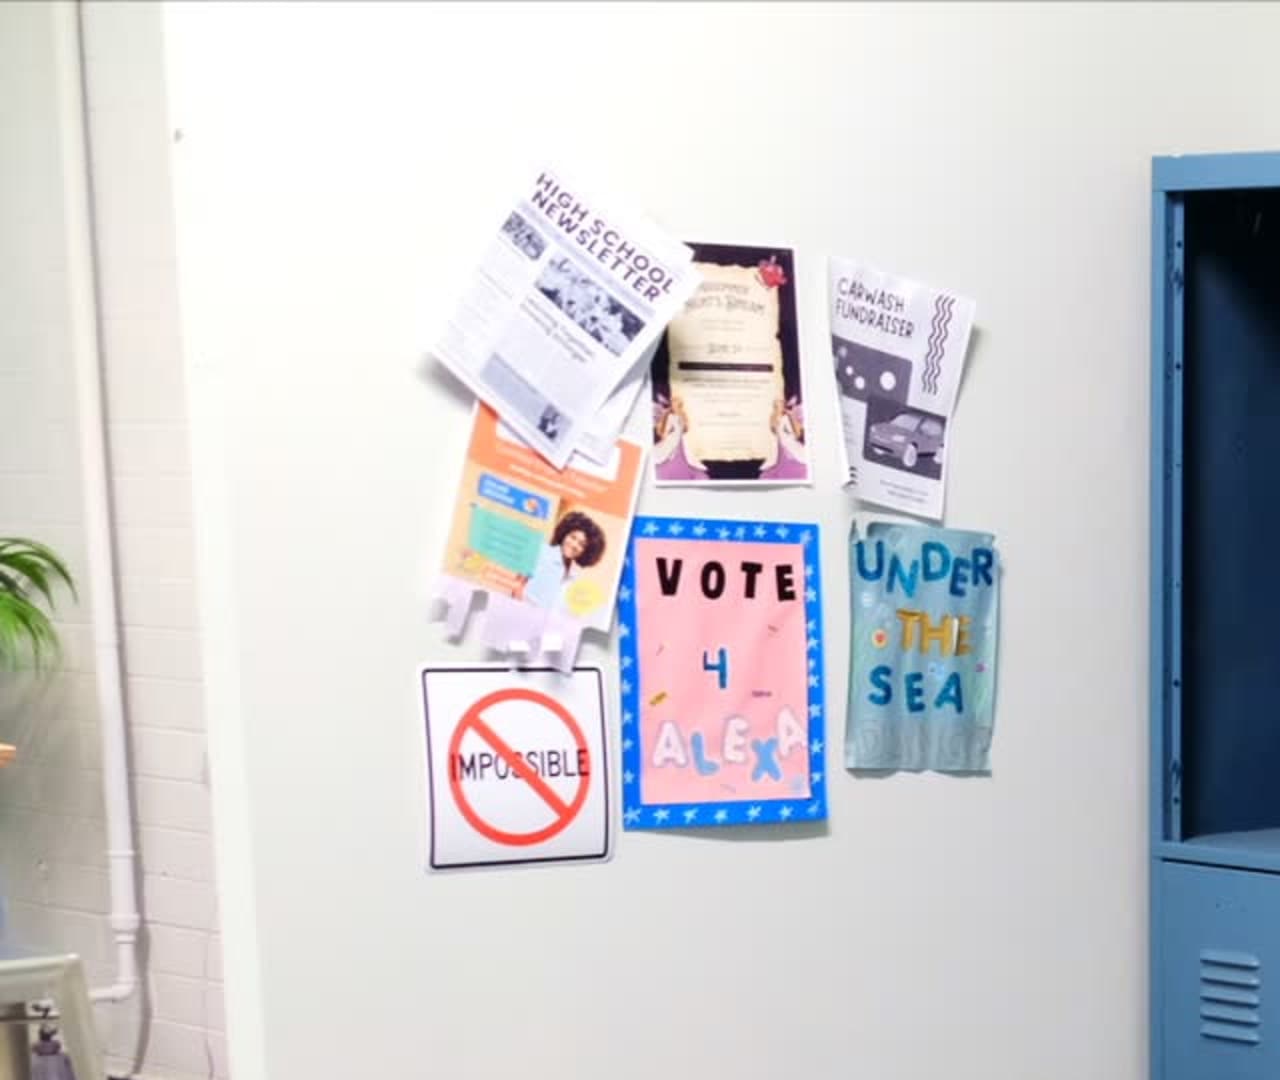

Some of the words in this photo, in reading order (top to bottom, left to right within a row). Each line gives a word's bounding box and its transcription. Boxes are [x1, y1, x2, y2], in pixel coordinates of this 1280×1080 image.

[531, 189, 661, 302] NEWSLETTER
[536, 173, 589, 222] HIGH
[590, 219, 675, 294] SCHOOL
[836, 299, 915, 338] FUNDRAISER
[838, 277, 905, 313] CARWASH
[655, 557, 797, 601] VOTE
[855, 540, 993, 598] UNDER
[896, 608, 974, 657] THE
[703, 648, 728, 689] 4
[868, 665, 963, 715] SEA
[653, 704, 807, 782] ALEXA
